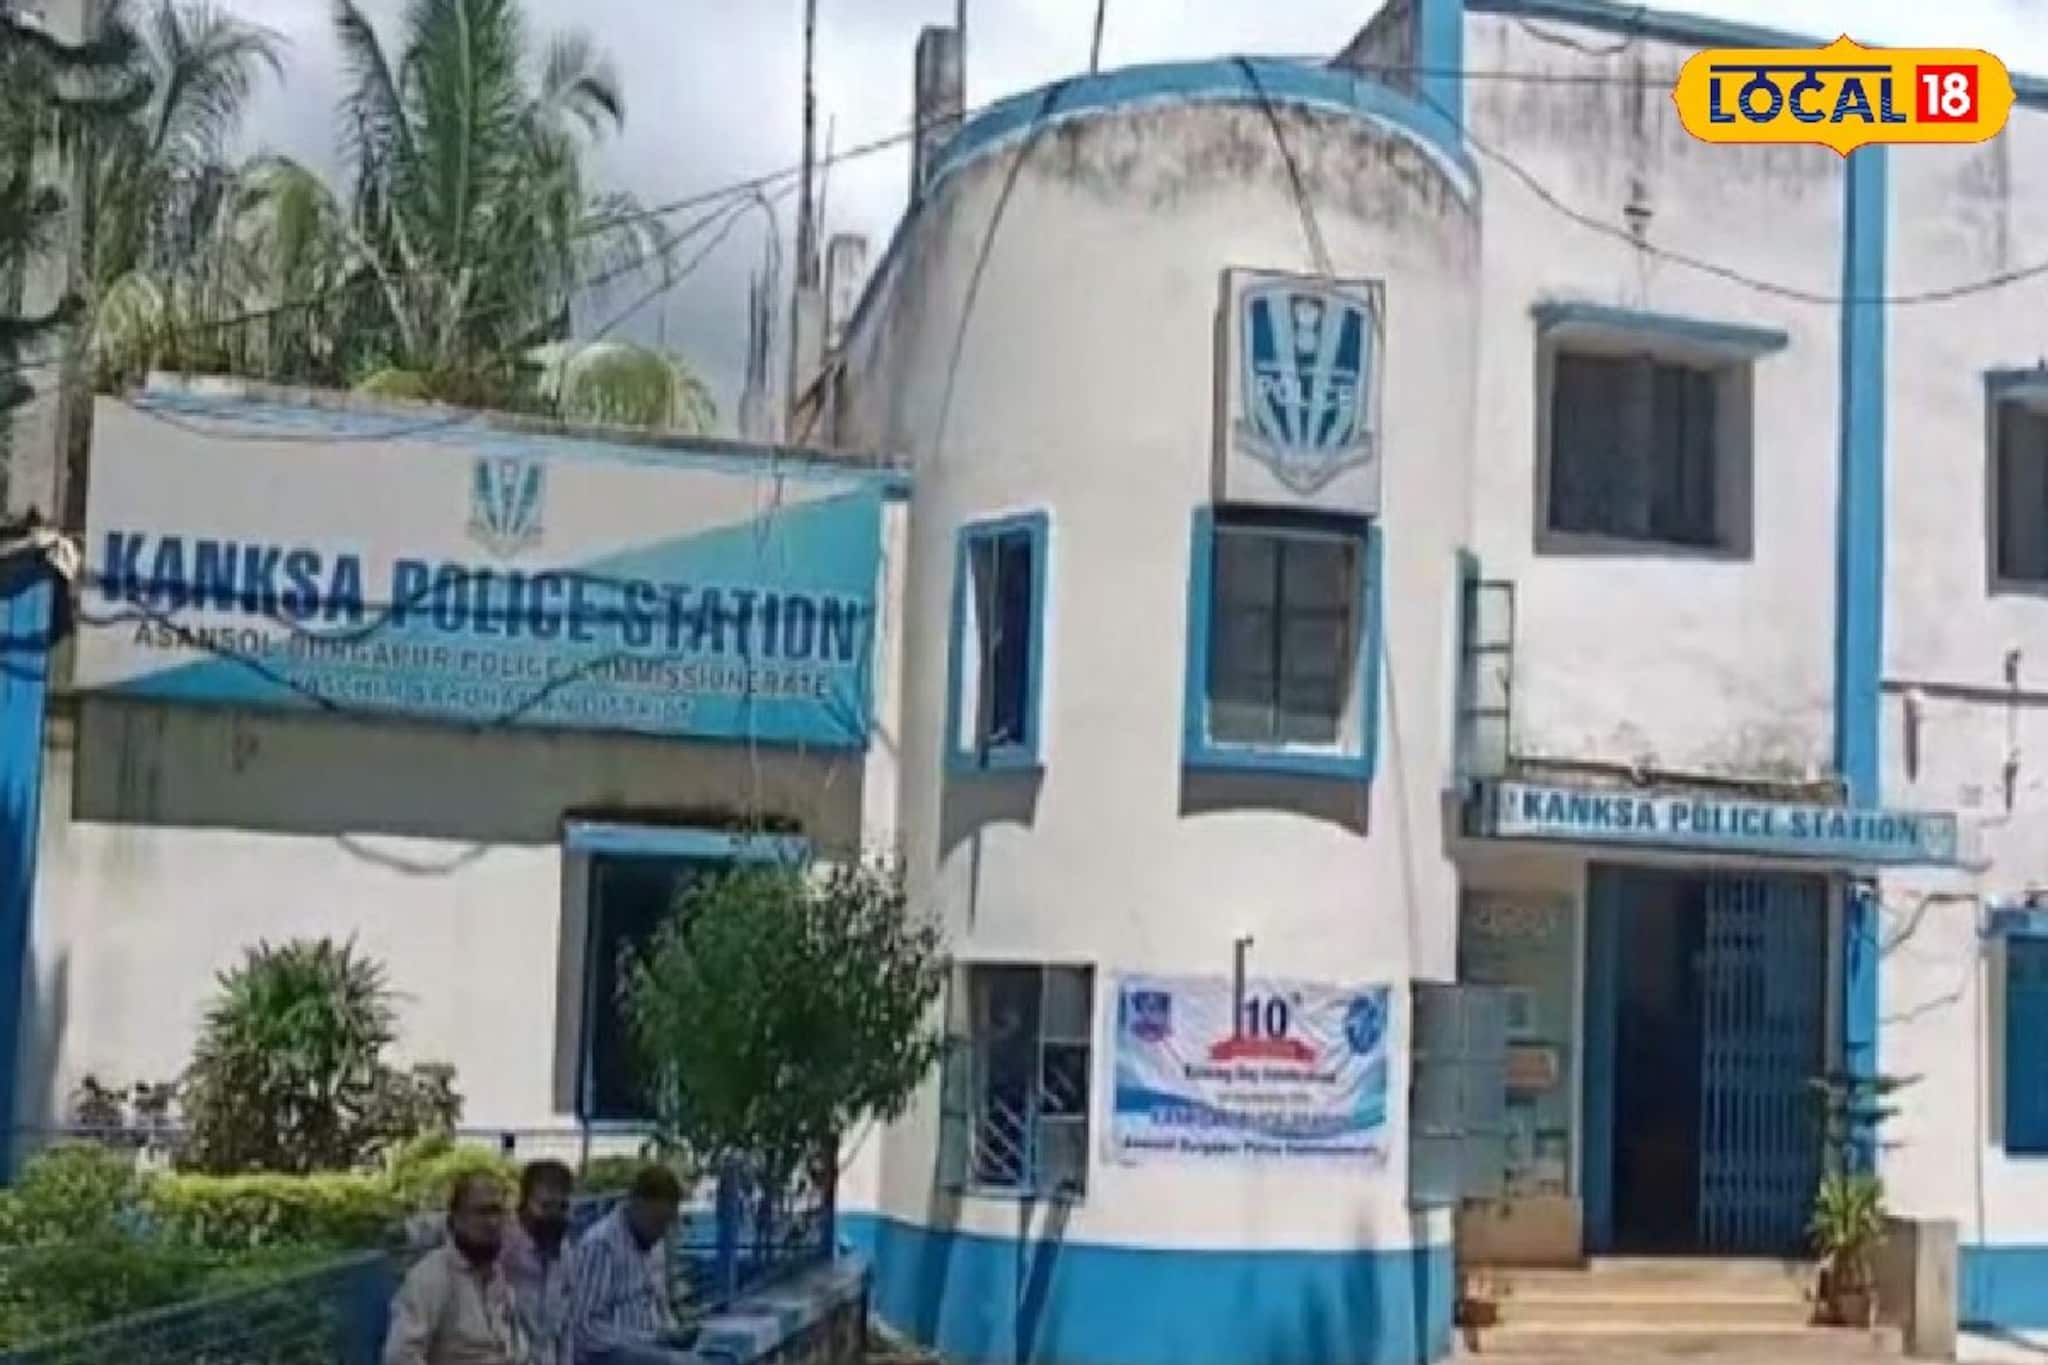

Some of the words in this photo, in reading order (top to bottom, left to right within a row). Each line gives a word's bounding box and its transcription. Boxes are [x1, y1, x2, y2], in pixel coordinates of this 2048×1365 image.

[102, 531, 366, 625] KANKSA
[391, 560, 594, 642] POLICE
[621, 579, 859, 661] STATION
[1522, 790, 1656, 828] KANKSA
[1671, 800, 1774, 836] POLICE
[1791, 809, 1919, 845] STATION
